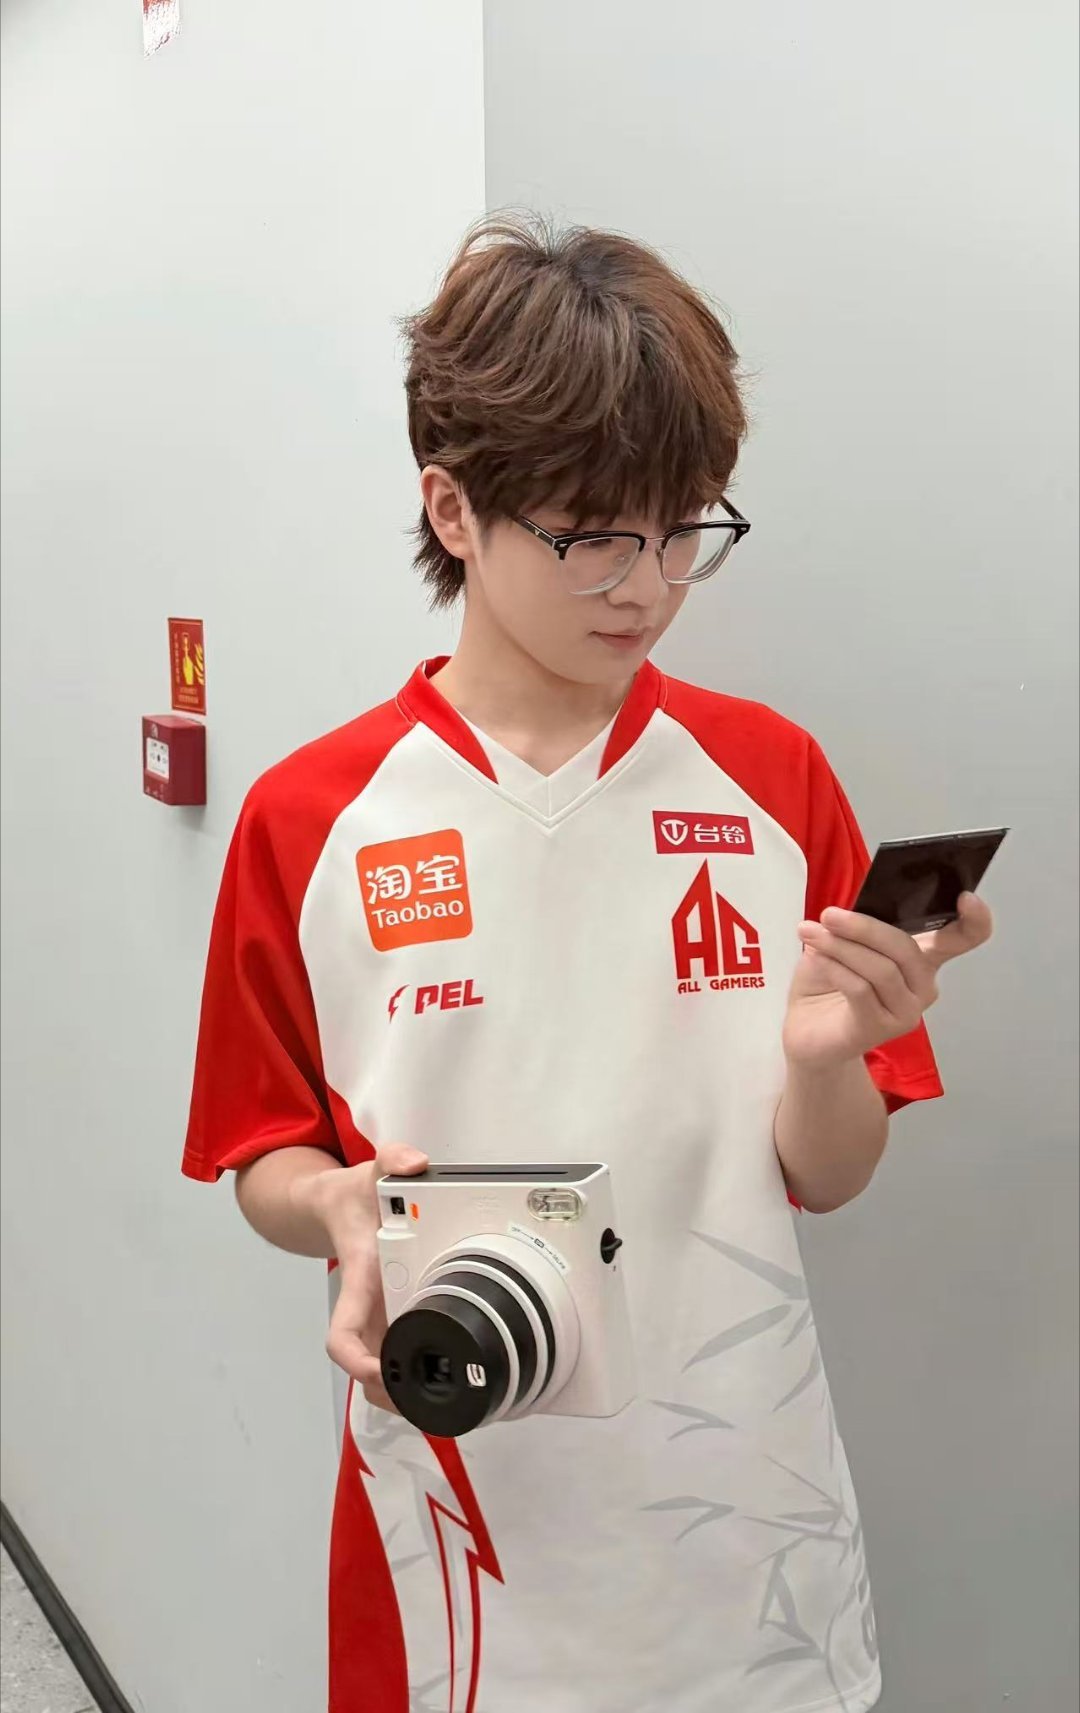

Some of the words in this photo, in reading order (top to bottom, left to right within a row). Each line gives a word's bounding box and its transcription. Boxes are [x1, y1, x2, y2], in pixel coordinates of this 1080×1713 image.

[693, 823, 746, 844] 台铃
[365, 854, 463, 904] 淘宝
[371, 899, 464, 929] Taobao
[671, 857, 763, 980] AG
[414, 979, 484, 1014] PEL
[677, 982, 702, 995] ALL
[709, 976, 765, 991] GAMERS
